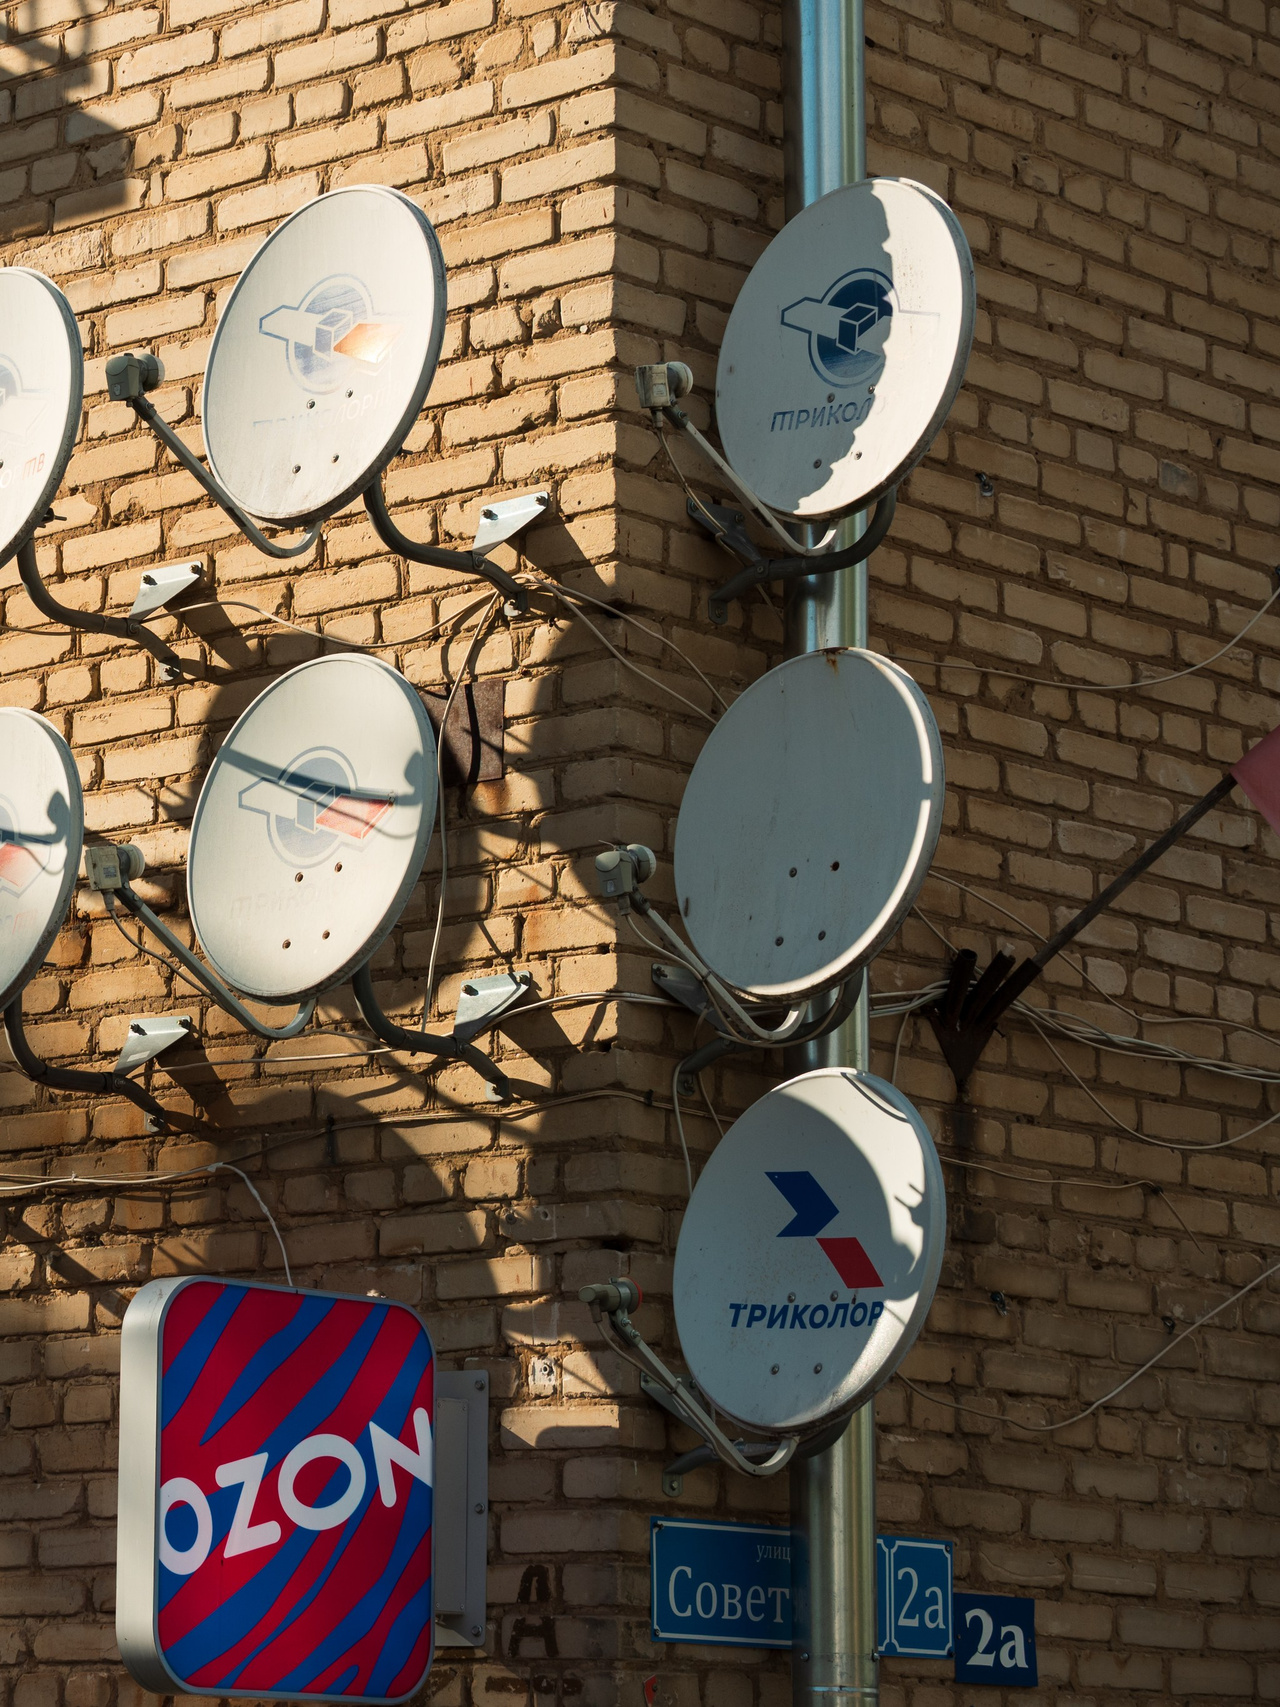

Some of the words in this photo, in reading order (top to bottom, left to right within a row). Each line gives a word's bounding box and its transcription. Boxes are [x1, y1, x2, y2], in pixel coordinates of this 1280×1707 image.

[728, 1300, 885, 1330] ТРИКОЛОР
[159, 1407, 434, 1576] OZON
[756, 1542, 791, 1565] улиц
[667, 1565, 791, 1625] Совет
[896, 1566, 946, 1630] 2а
[964, 1607, 1030, 1670] 2а
